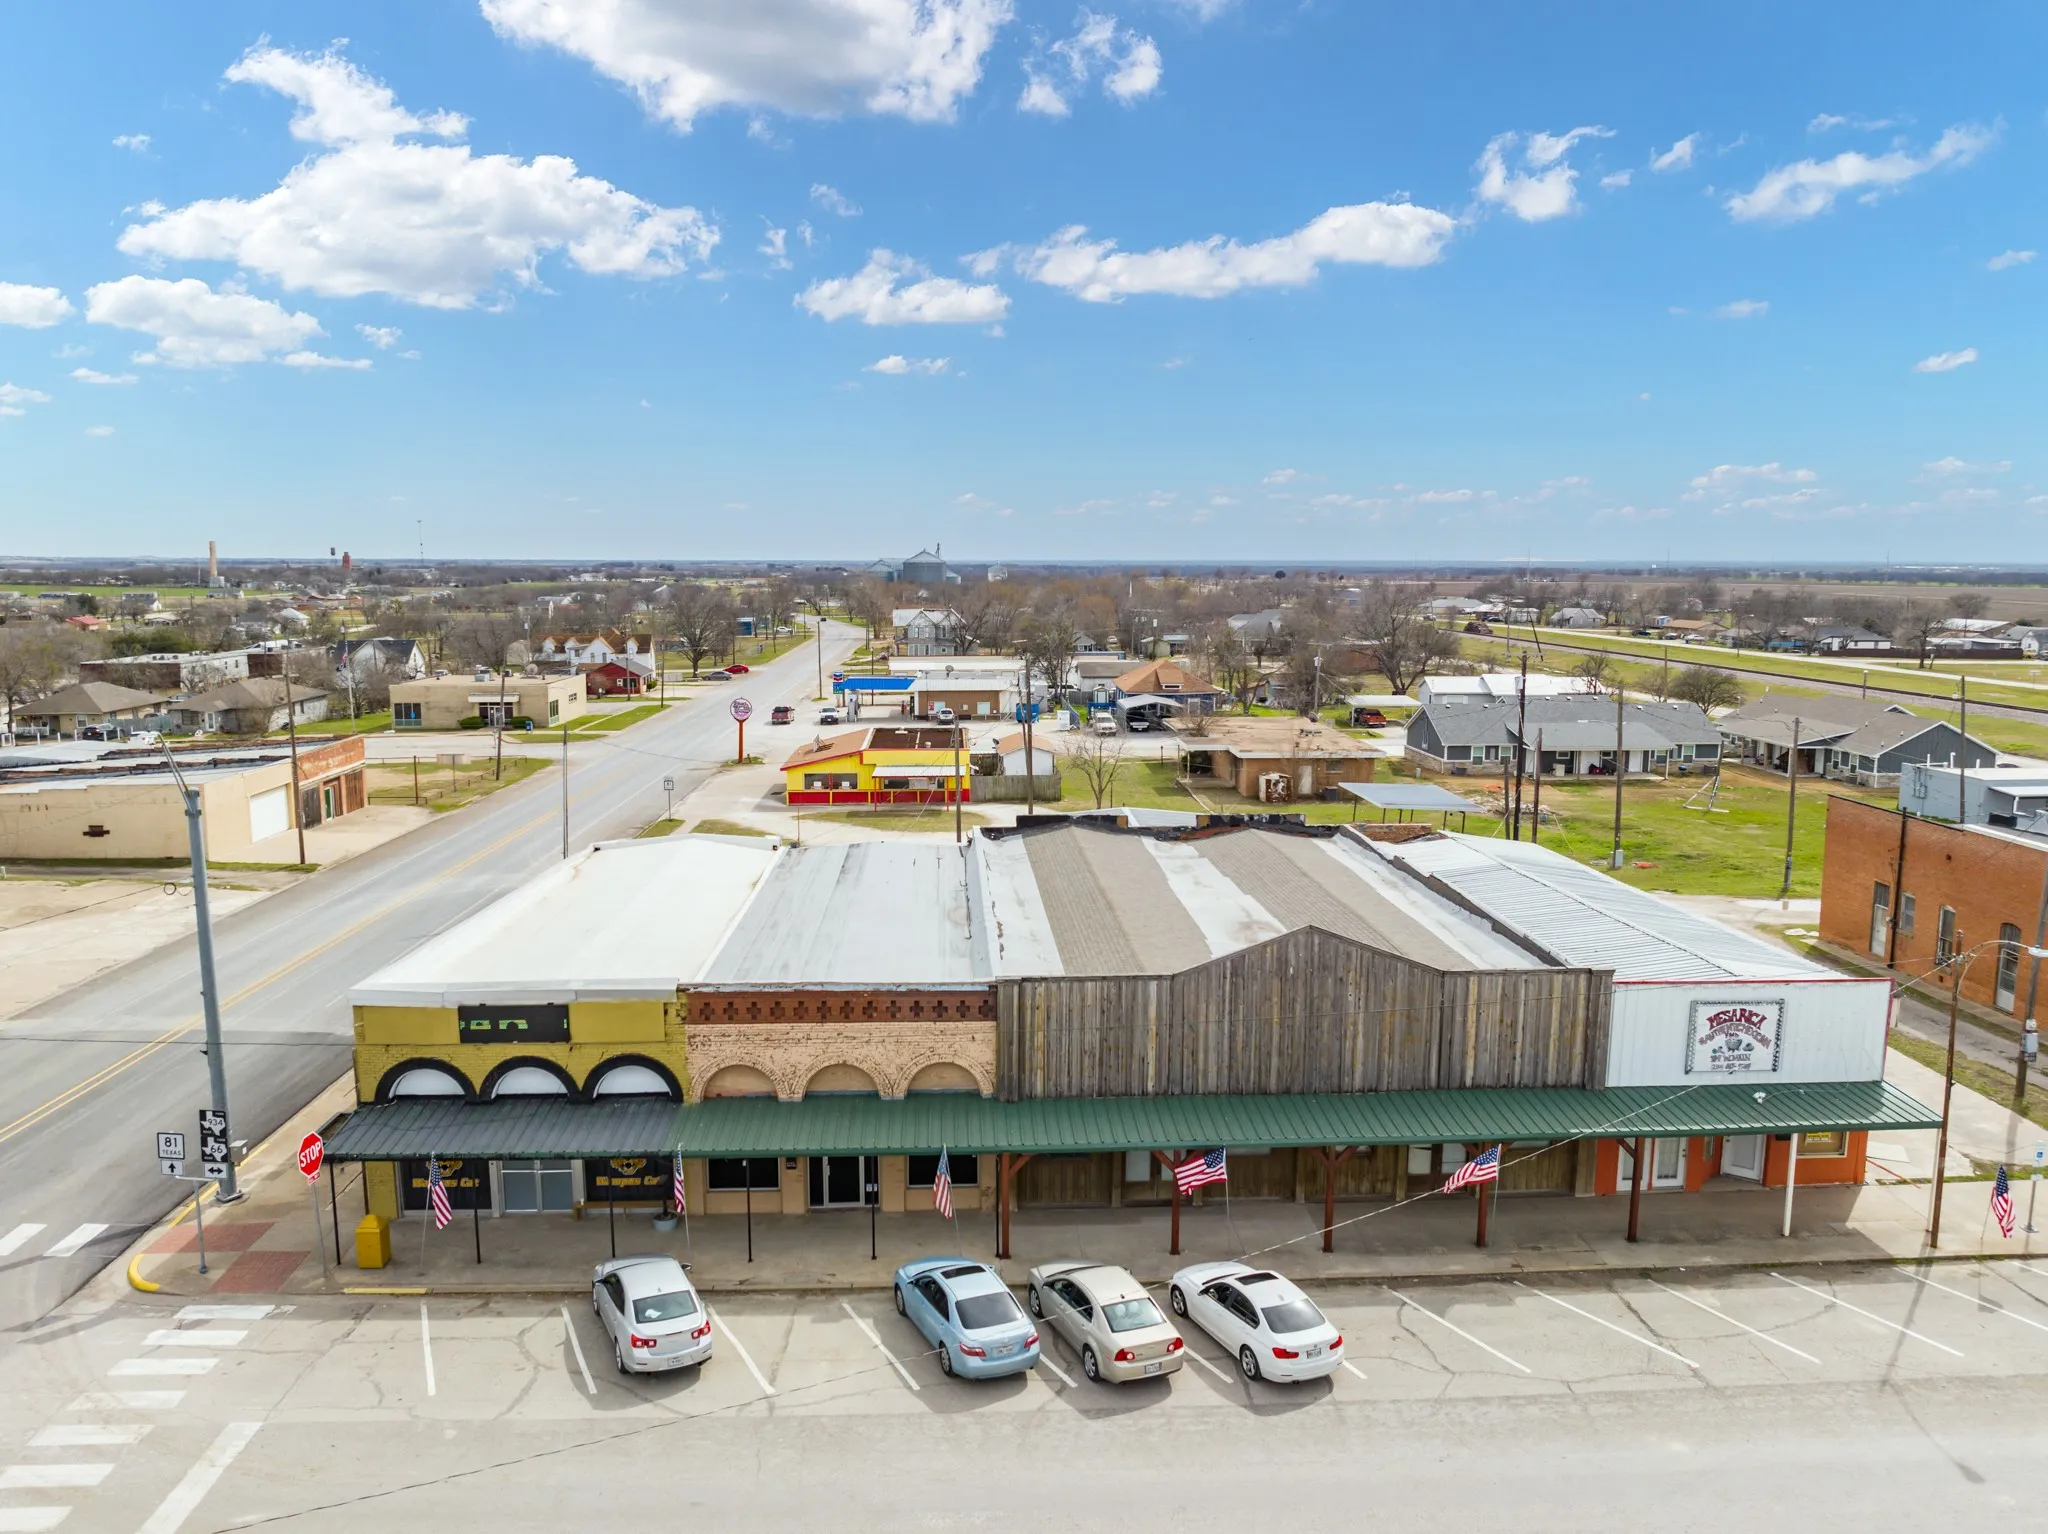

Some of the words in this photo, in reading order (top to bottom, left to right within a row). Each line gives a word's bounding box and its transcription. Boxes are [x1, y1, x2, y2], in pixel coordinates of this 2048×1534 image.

[1706, 1008, 1737, 1030] MESA
[1738, 1008, 1767, 1030] RICA
[208, 1118, 223, 1127] 934
[164, 1136, 178, 1148] 81
[210, 1144, 223, 1153] 66
[300, 1141, 321, 1168] STOP
